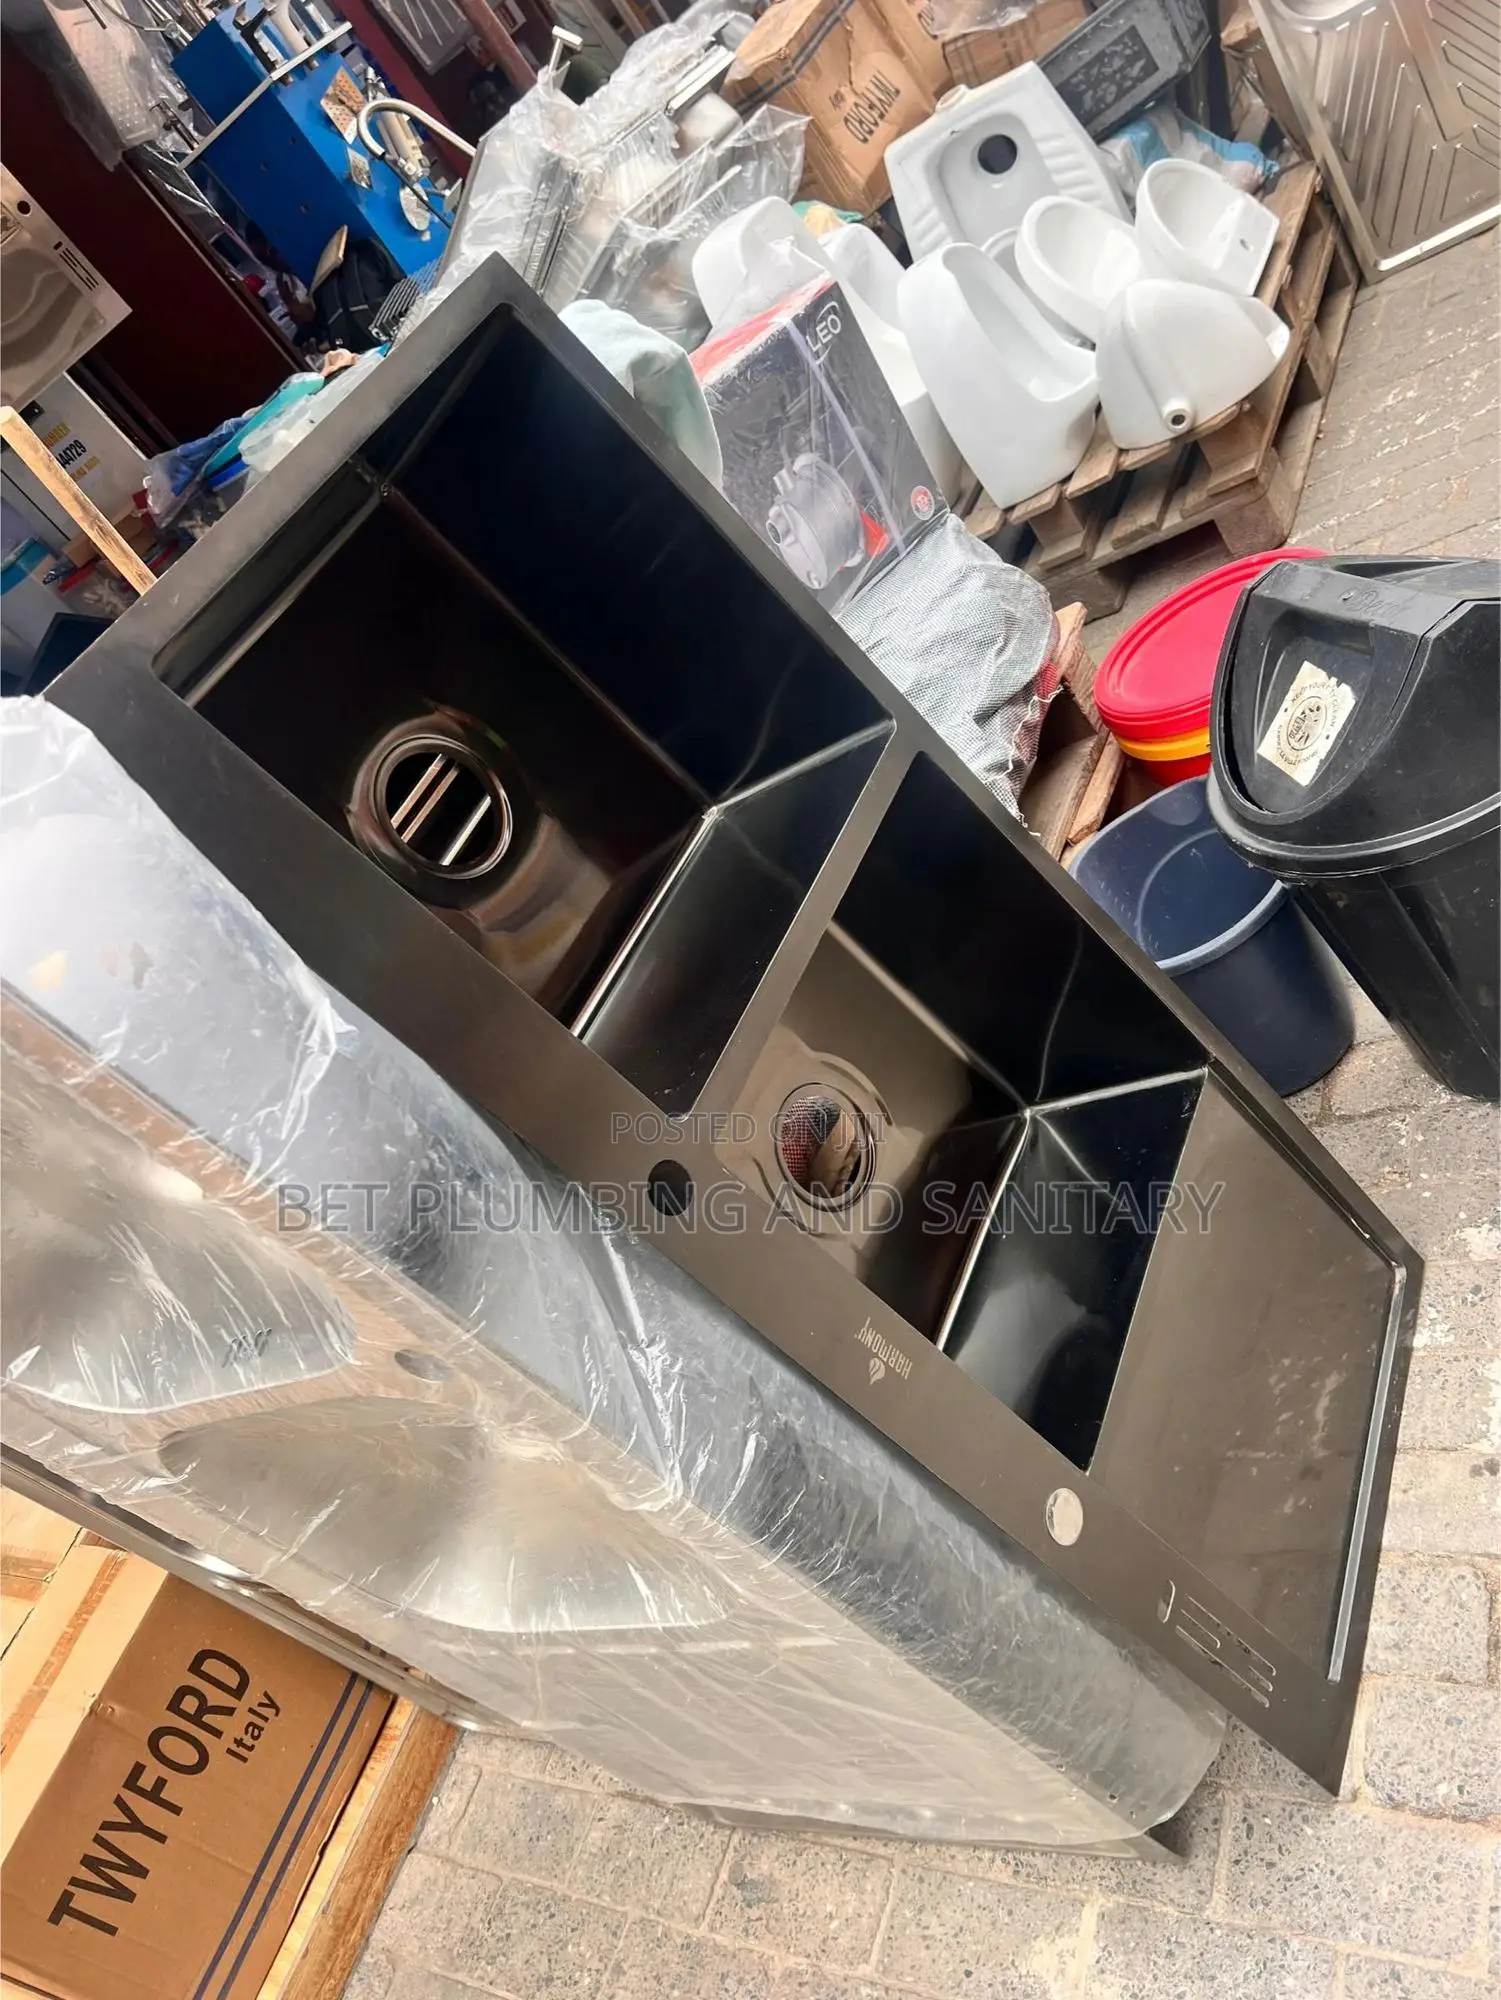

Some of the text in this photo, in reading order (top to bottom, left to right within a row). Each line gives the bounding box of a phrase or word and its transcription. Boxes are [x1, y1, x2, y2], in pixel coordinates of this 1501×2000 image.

[843, 68, 901, 145] TWYFORD
[805, 313, 842, 352] LEO
[857, 1316, 913, 1380] HARMONY
[225, 1689, 281, 1764] Italy
[47, 1648, 250, 1937] TWYFORD
